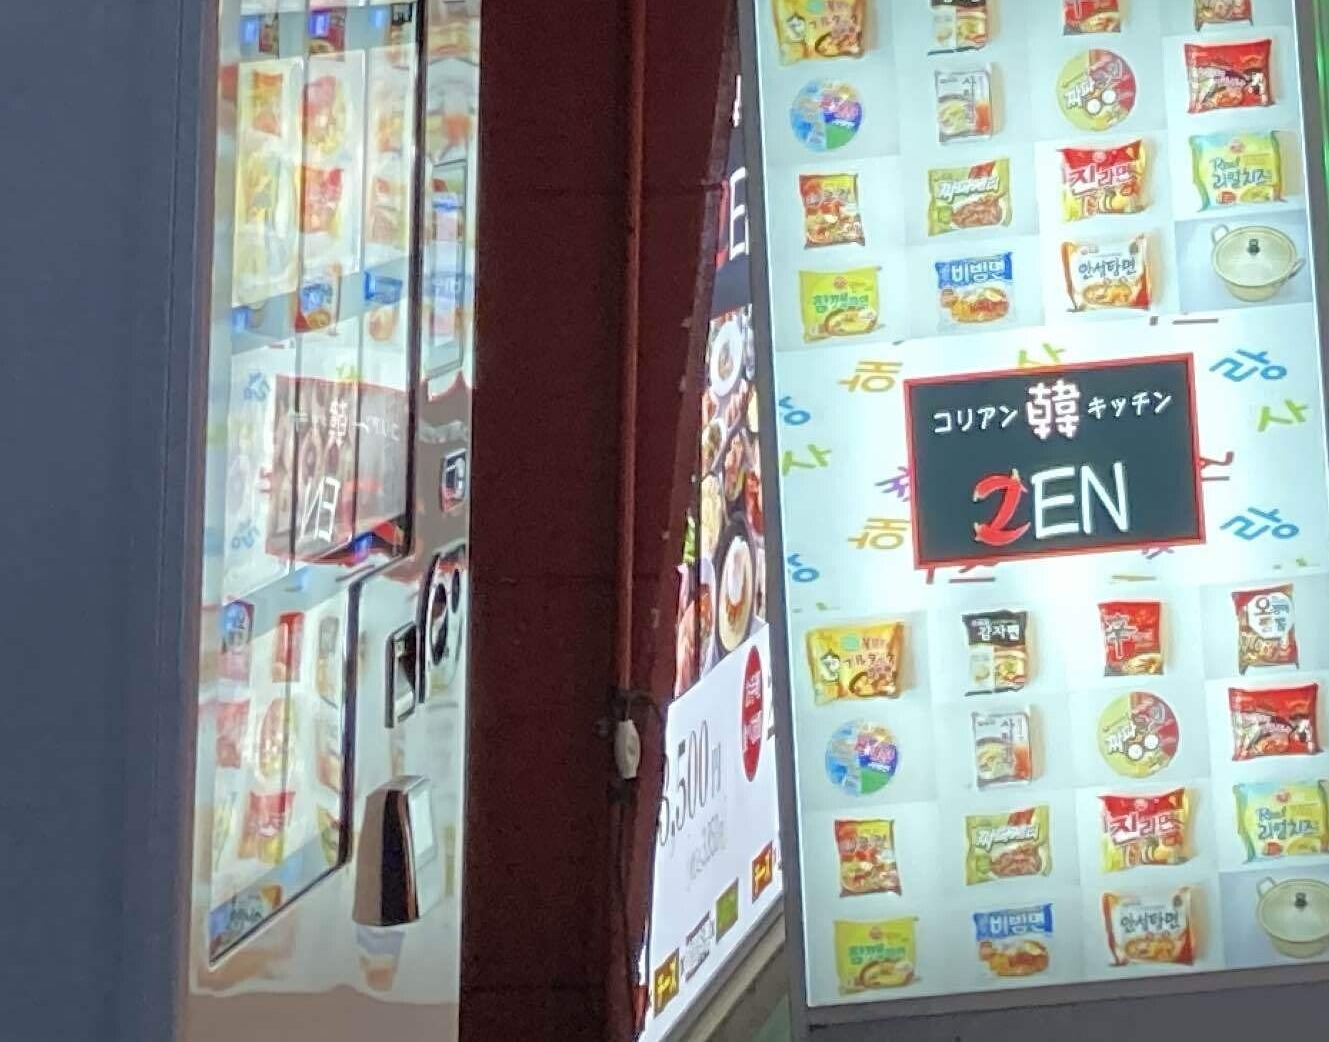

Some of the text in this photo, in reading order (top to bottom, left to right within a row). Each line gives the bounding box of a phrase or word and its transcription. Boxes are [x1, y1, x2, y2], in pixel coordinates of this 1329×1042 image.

[951, 262, 1005, 280] 비빔면
[1079, 260, 1136, 279] 안성탕면
[973, 461, 1131, 546] ZEN
[990, 914, 1045, 935] 비빔면
[1120, 911, 1179, 933] 안성탕면
